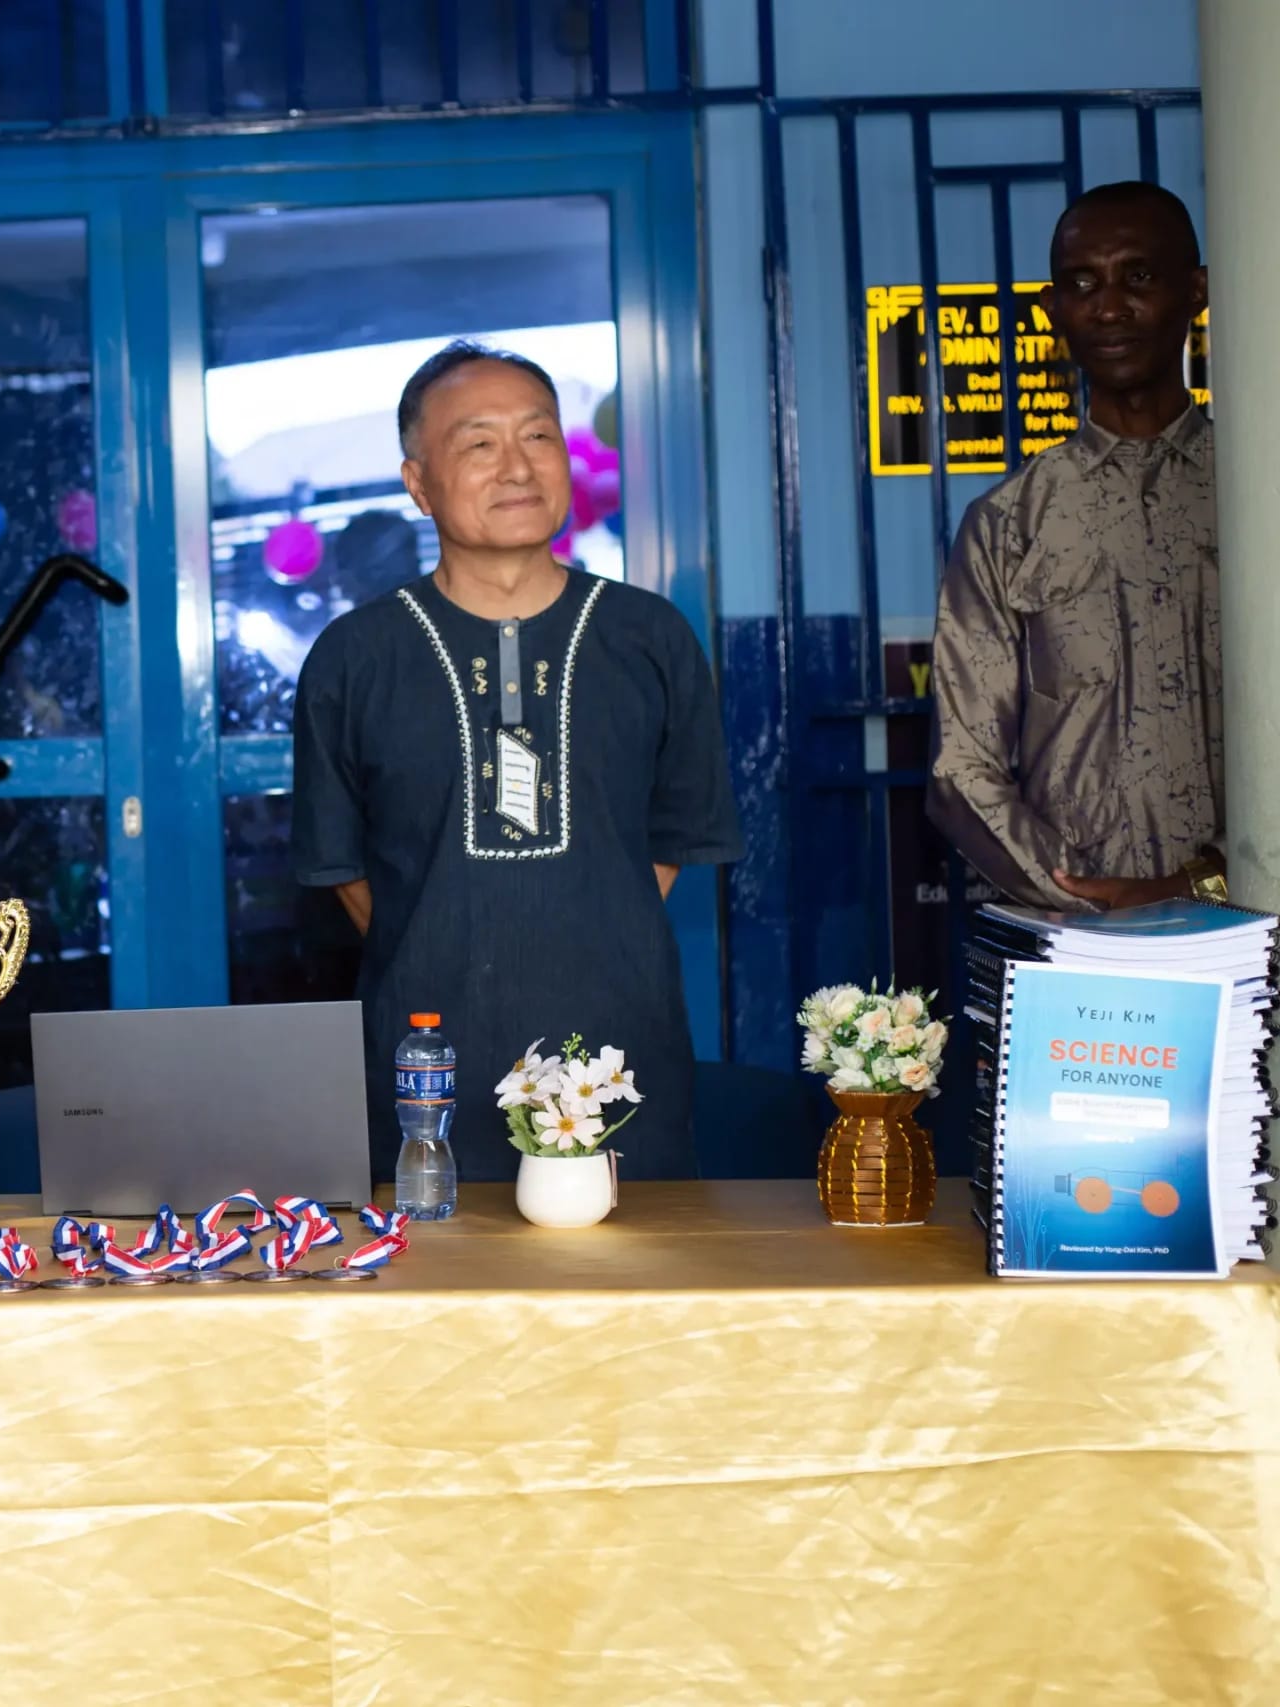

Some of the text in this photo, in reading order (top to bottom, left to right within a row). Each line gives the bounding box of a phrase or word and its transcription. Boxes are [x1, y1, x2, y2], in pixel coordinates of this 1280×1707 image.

[1032, 391, 1070, 411] AND
[1024, 412, 1080, 431] for the
[945, 434, 1005, 456] arental
[1049, 1039, 1179, 1070] SCIENCE
[1061, 1069, 1164, 1089] FOR ANYONE
[63, 1108, 104, 1117] SAMSUNG
[1095, 1245, 1104, 1254] by
